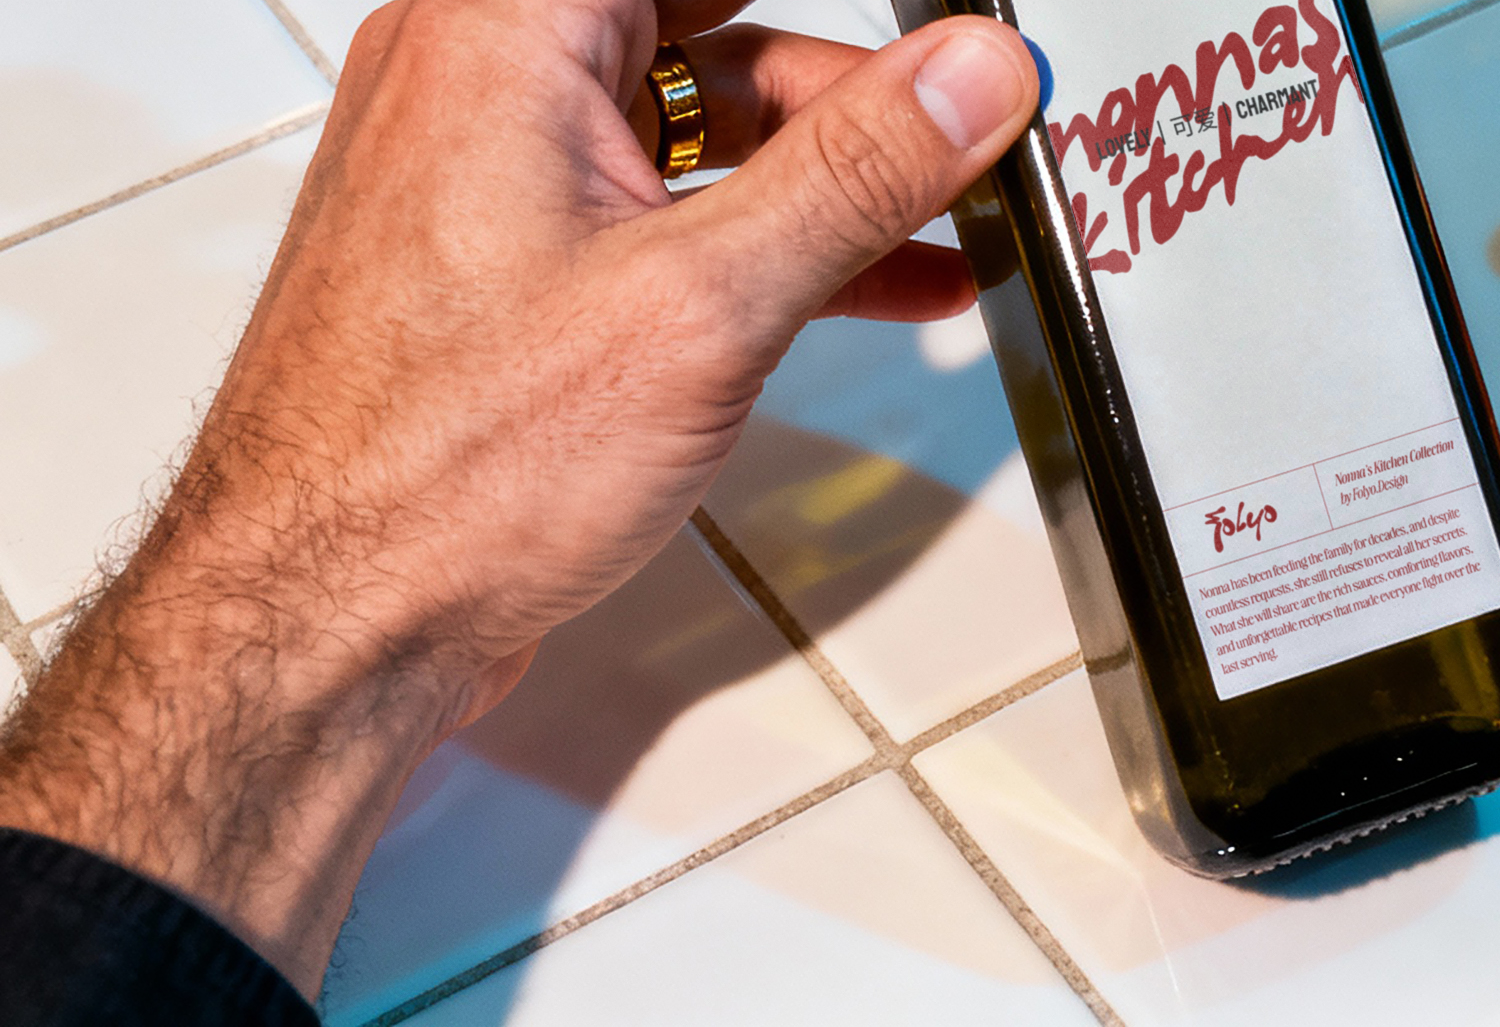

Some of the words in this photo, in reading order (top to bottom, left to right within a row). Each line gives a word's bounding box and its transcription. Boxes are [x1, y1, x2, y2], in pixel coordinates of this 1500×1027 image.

[1071, 54, 1365, 274] kitchen
[1095, 127, 1151, 162] LOVELY
[1170, 106, 1218, 138] 可爱
[1235, 78, 1320, 120] CHARMANT
[1334, 464, 1372, 486] Nonna's
[1373, 454, 1407, 474] Kitchen
[1409, 440, 1454, 462] Collection
[1340, 492, 1351, 506] by
[1352, 474, 1408, 501] Folyo.Design
[1198, 583, 1230, 600] Nonna
[1229, 577, 1249, 590] has
[1247, 569, 1273, 584] been
[1272, 556, 1308, 576] feeding
[1307, 552, 1323, 565] the
[1323, 542, 1352, 560] family
[1352, 538, 1367, 550] for
[1367, 526, 1409, 545] decades,
[1408, 516, 1427, 532] and
[1427, 508, 1460, 526] despite
[1205, 596, 1250, 618] countless
[1249, 583, 1294, 604] requests,
[1293, 577, 1310, 590] she
[1310, 569, 1328, 584] still
[1328, 560, 1364, 578] refuses
[1363, 556, 1374, 567] to
[1373, 544, 1403, 564] reveal
[1402, 540, 1415, 554] all
[1413, 537, 1431, 550] her
[1431, 527, 1467, 545] secrets.
[1209, 620, 1237, 636] What
[1236, 615, 1254, 629] she
[1253, 607, 1272, 622] will
[1272, 601, 1299, 617] share
[1299, 595, 1316, 608] are
[1316, 590, 1332, 602] the
[1332, 582, 1352, 597] rich
[1351, 573, 1387, 591] sauces,
[1387, 554, 1439, 579] comforting
[1437, 545, 1473, 563] flavors,
[1215, 639, 1235, 656] and
[1235, 620, 1297, 649] unforgettable
[1297, 610, 1333, 629] recipes
[1332, 603, 1352, 617] that
[1352, 594, 1379, 611] made
[1379, 581, 1421, 602] everyone
[1421, 573, 1444, 589] fight
[1443, 566, 1464, 581] over
[1464, 562, 1480, 574] the
[1220, 660, 1239, 674] last
[1239, 647, 1278, 668] serving.
